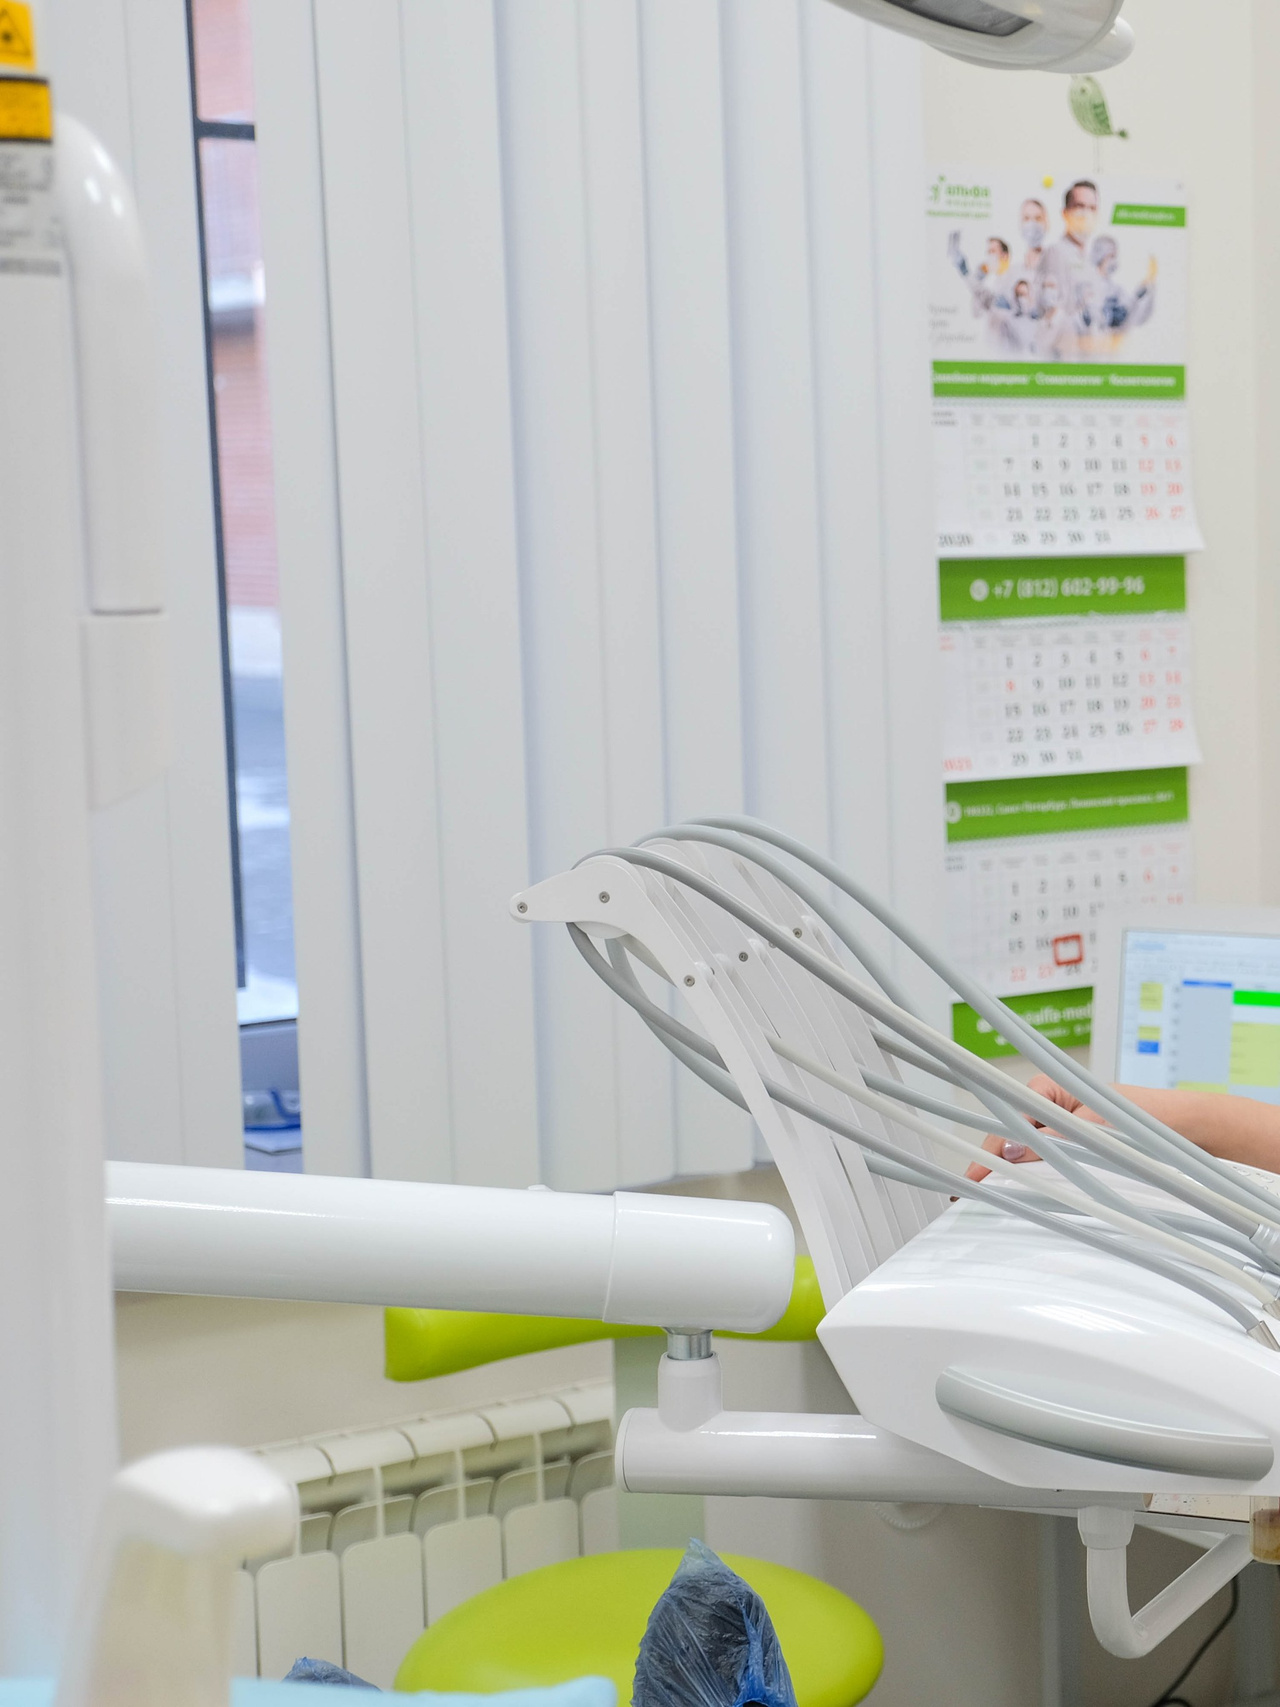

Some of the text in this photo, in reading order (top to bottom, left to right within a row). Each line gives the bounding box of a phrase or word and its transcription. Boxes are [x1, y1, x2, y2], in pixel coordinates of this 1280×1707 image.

[992, 575, 1145, 600] +7 (812) 602-99-96
